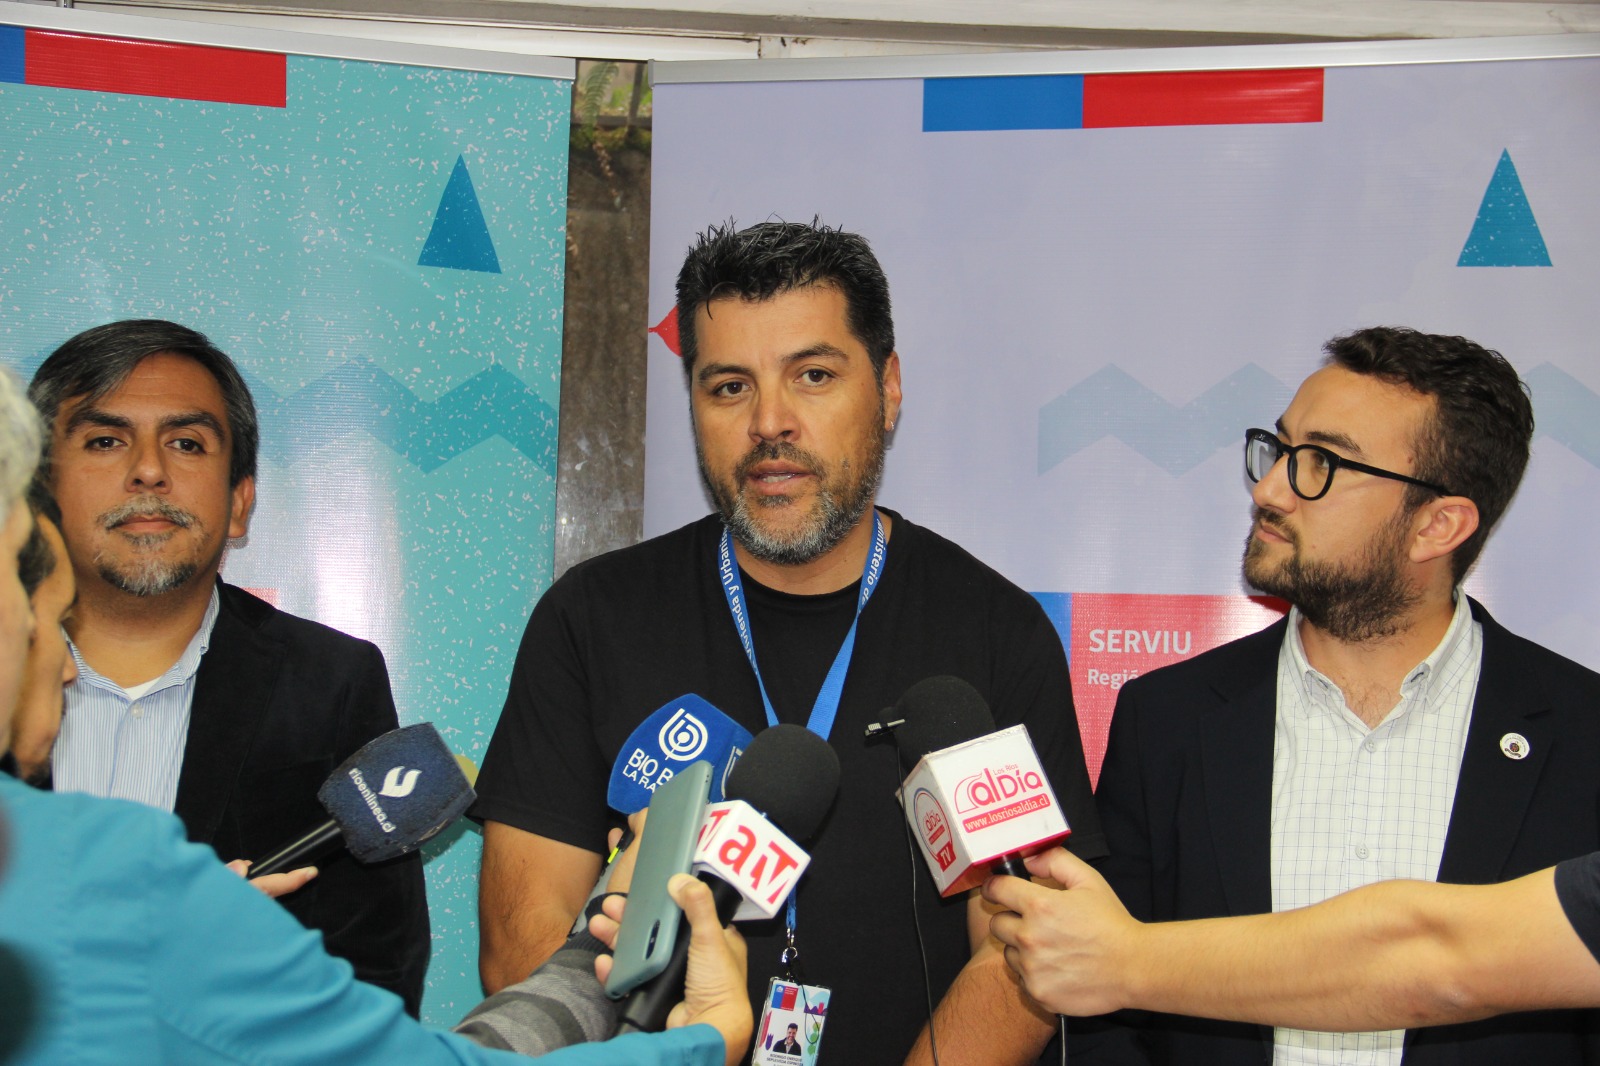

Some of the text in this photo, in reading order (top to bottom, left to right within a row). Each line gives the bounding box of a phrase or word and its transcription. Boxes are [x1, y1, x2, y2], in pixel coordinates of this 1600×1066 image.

[728, 585, 740, 596] y
[1089, 628, 1192, 655] SERVIU
[622, 764, 657, 794] LA RA
[627, 747, 674, 786] BIO B
[348, 767, 397, 833] rioenlinea.cl
[965, 797, 1049, 831] www.losriosaldia.cl
